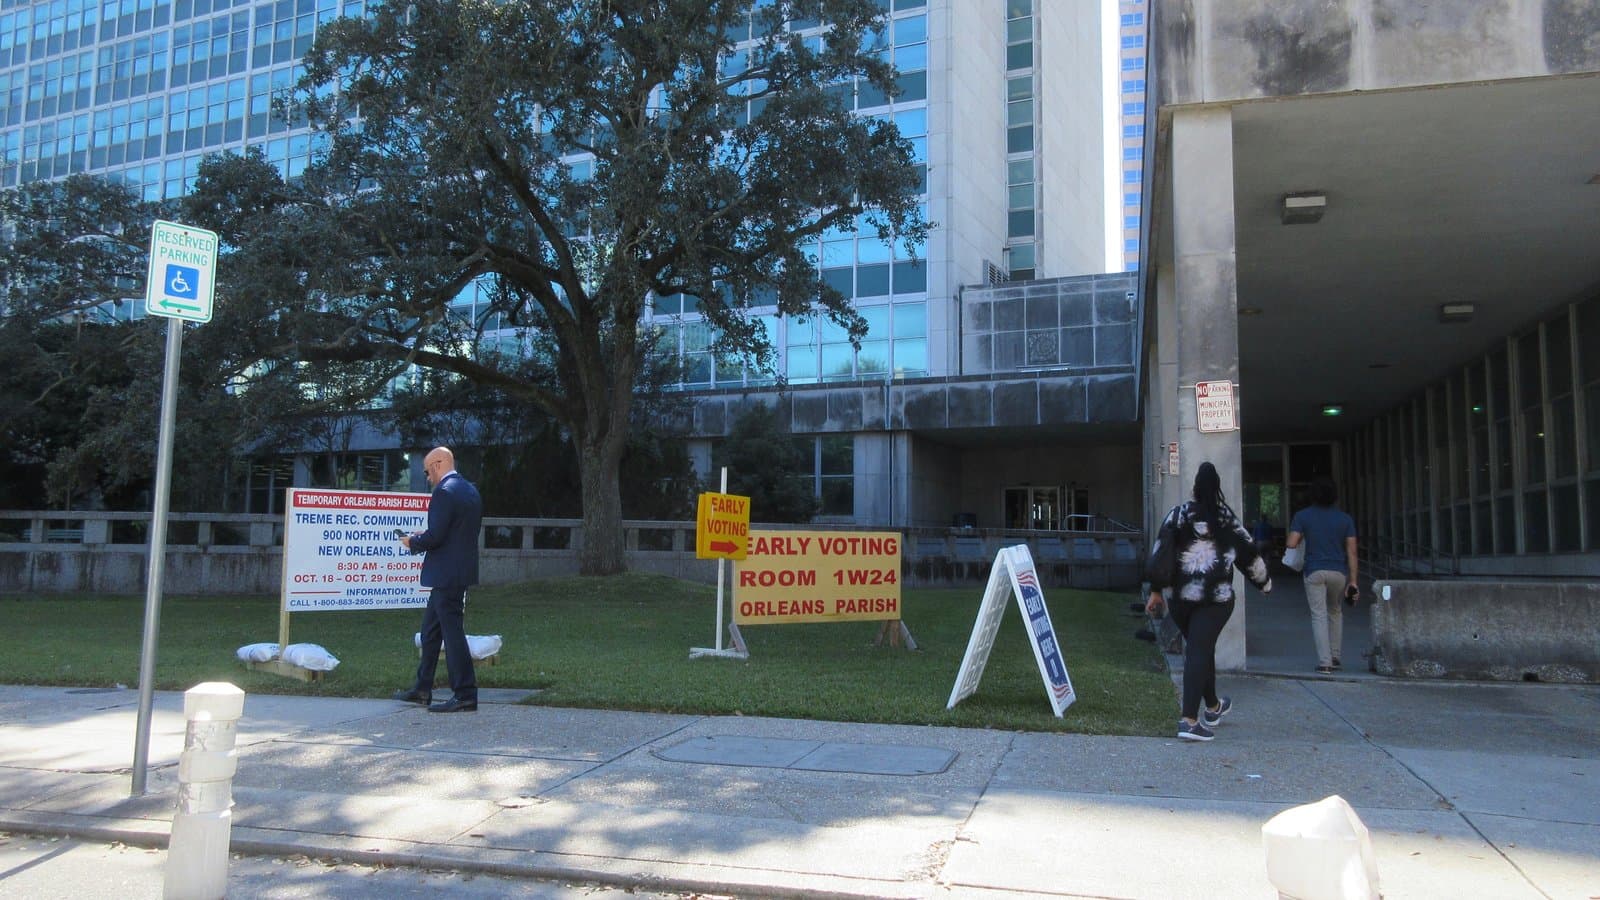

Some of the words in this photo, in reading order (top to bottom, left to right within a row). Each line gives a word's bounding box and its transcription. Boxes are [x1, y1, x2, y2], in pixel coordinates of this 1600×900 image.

[158, 230, 212, 252] RESERVED
[160, 246, 208, 266] PARKING
[1198, 384, 1208, 397] NO
[1200, 400, 1232, 409] MUNICIPAL
[1201, 409, 1231, 418] PROPERTY
[298, 494, 342, 505] TEMPORARY
[343, 497, 377, 507] ORLEANS
[377, 498, 402, 508] PARISH
[403, 498, 424, 508] EARLY
[425, 499, 430, 508] V
[711, 497, 745, 515] EARLY
[296, 513, 333, 525] TREME
[335, 514, 360, 526] REC.
[363, 515, 424, 527] COMMUNITY
[707, 519, 747, 536] VOTING
[323, 530, 342, 540] 900
[345, 530, 380, 541] NORTH
[319, 545, 343, 556] NEW
[345, 546, 396, 557] ORLEANS,
[746, 537, 811, 556] EARLY
[818, 537, 897, 556] VOTING
[337, 562, 359, 571] 8:30
[361, 562, 378, 571] AM
[387, 562, 408, 571] 6:00
[294, 574, 318, 583] OCT.
[321, 574, 334, 583] 18
[344, 574, 368, 583] OCT.
[370, 574, 383, 583] 29
[385, 573, 420, 584] (except
[740, 570, 816, 587] ROOM
[833, 570, 896, 586] 1W24
[346, 588, 407, 597] INFORMATION
[740, 600, 824, 617] ORLEANS
[836, 599, 897, 614] PARISH
[1026, 594, 1042, 615] EARLY
